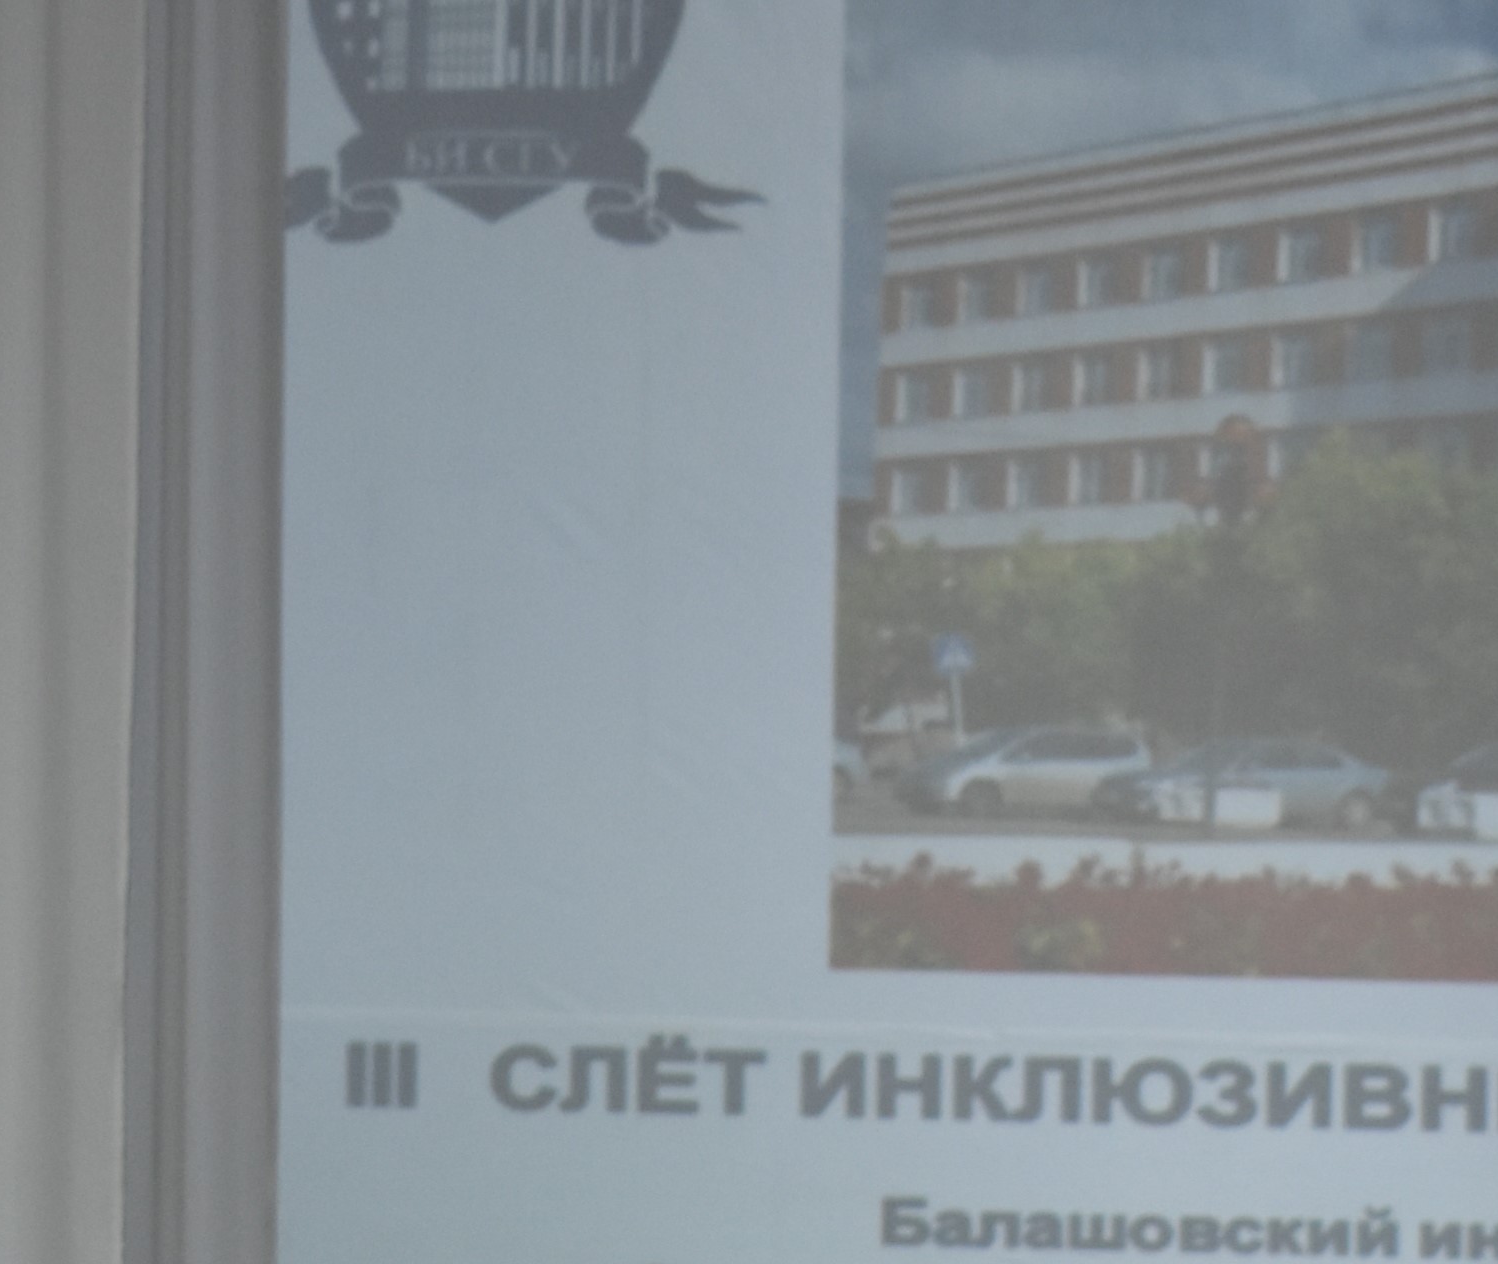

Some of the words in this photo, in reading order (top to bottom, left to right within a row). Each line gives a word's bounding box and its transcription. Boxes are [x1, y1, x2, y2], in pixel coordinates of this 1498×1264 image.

[346, 1042, 418, 1109] III
[491, 1035, 767, 1116] СЛЁТ
[882, 1197, 1398, 1257] Балашовский
